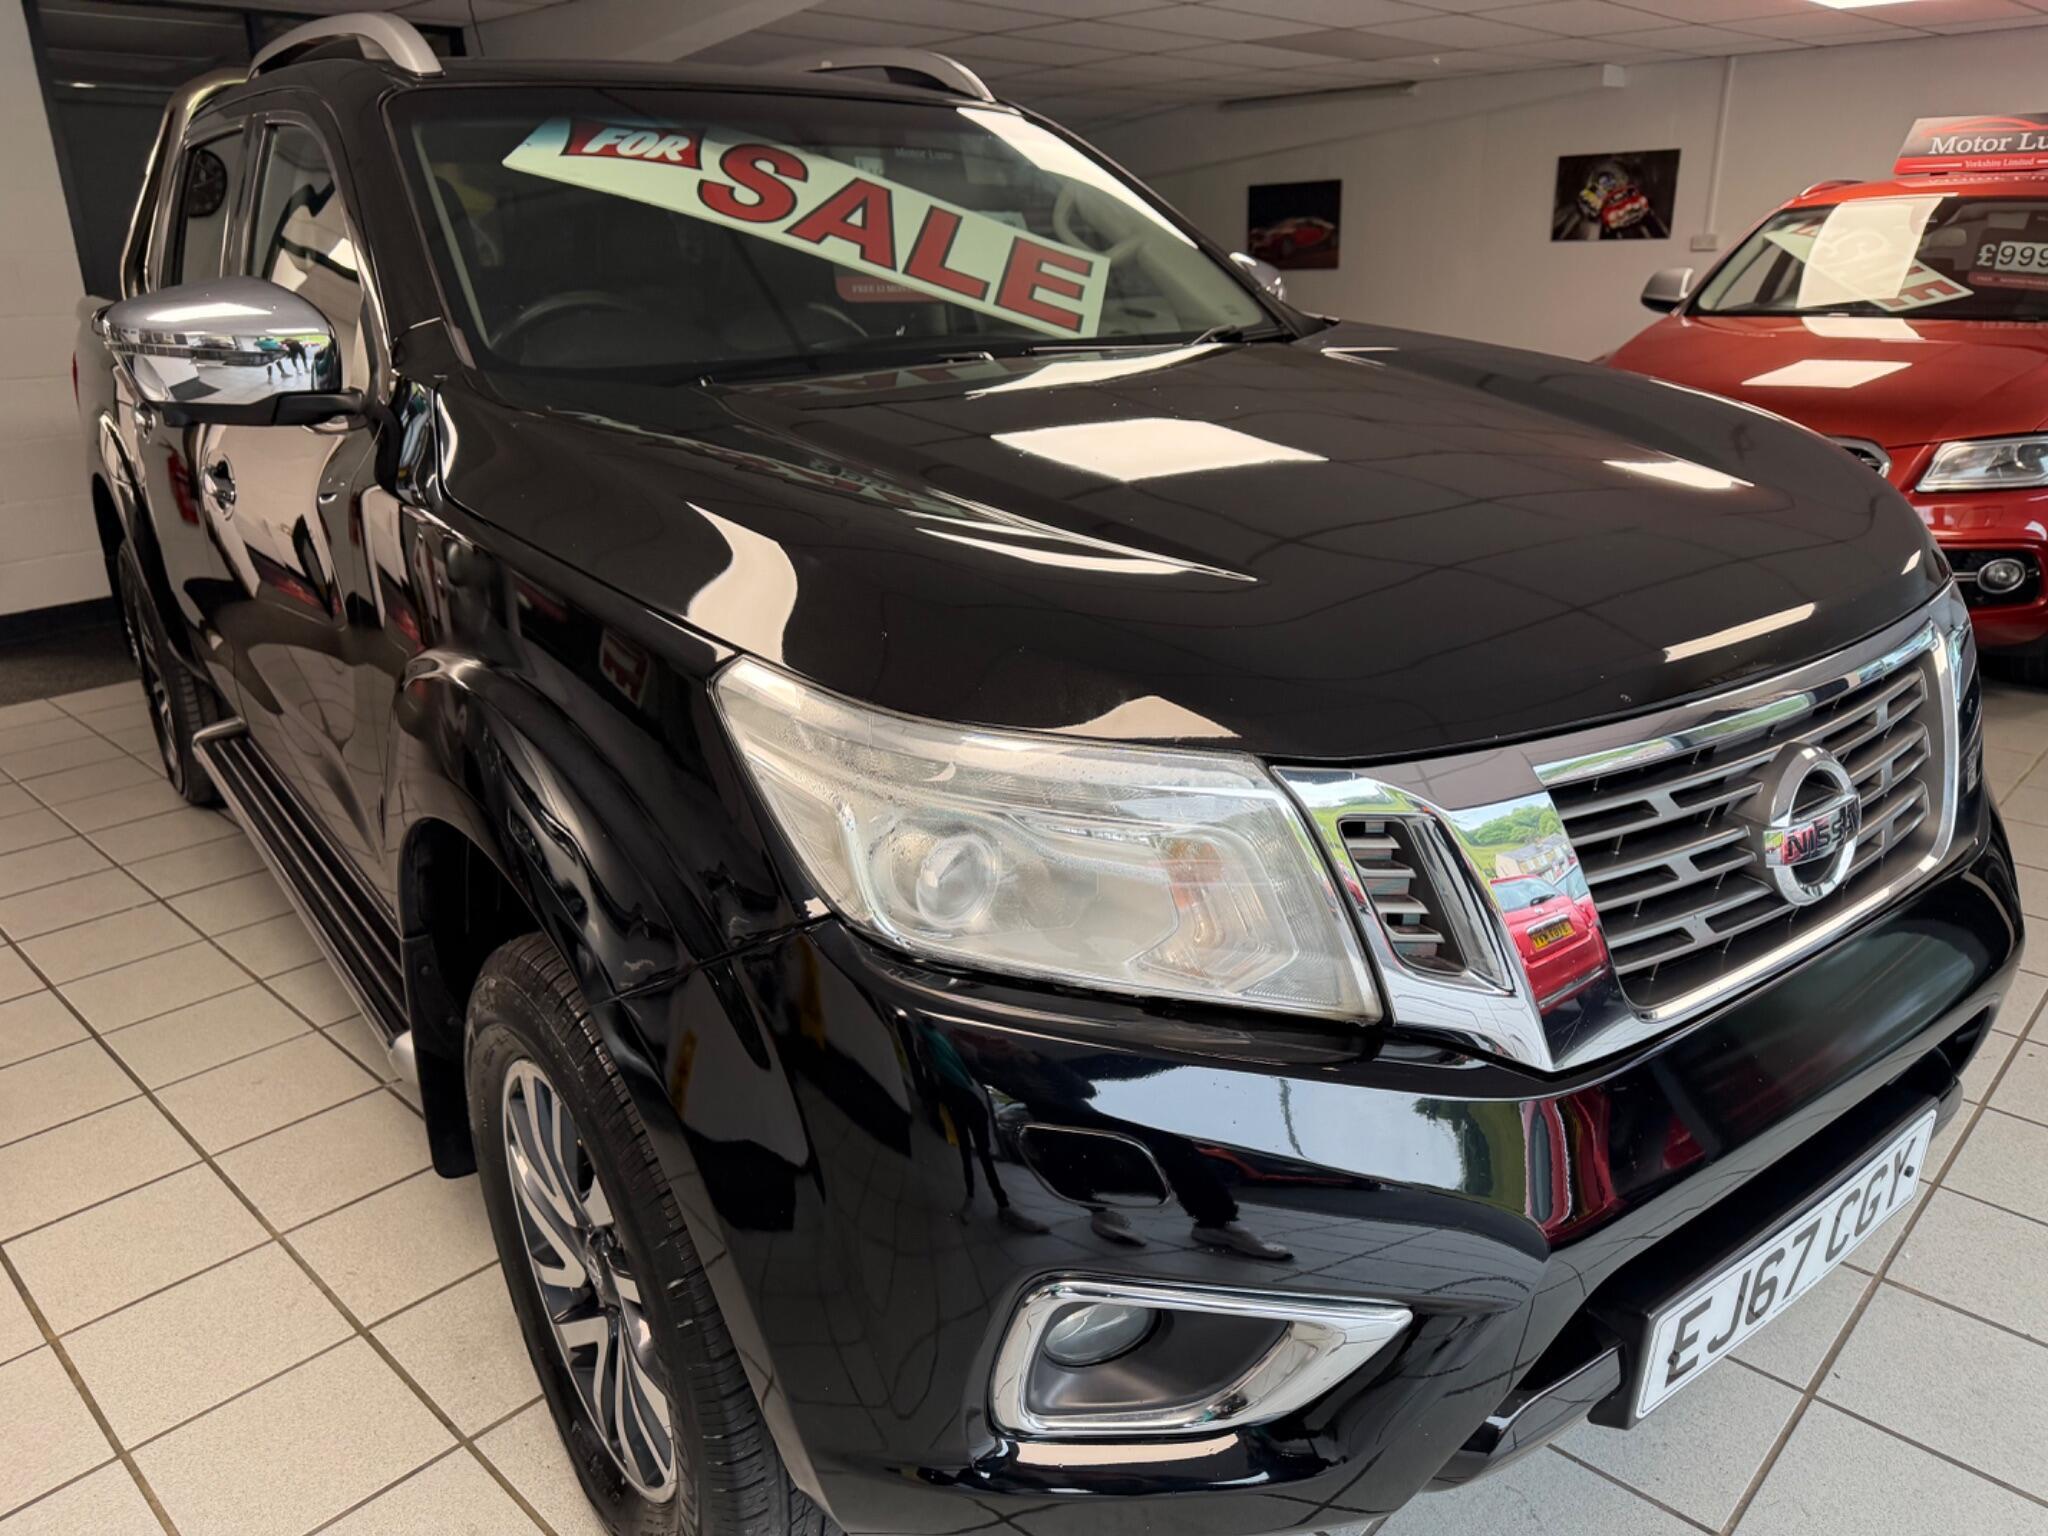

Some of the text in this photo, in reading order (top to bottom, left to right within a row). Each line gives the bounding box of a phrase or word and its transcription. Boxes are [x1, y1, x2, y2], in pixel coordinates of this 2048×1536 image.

[1928, 135, 2012, 154] Motor
[1965, 157, 2034, 168] Yorkshire Limited
[582, 127, 1094, 334] FOR SALE
[1665, 1136, 1917, 1388] EJ67 CGY
